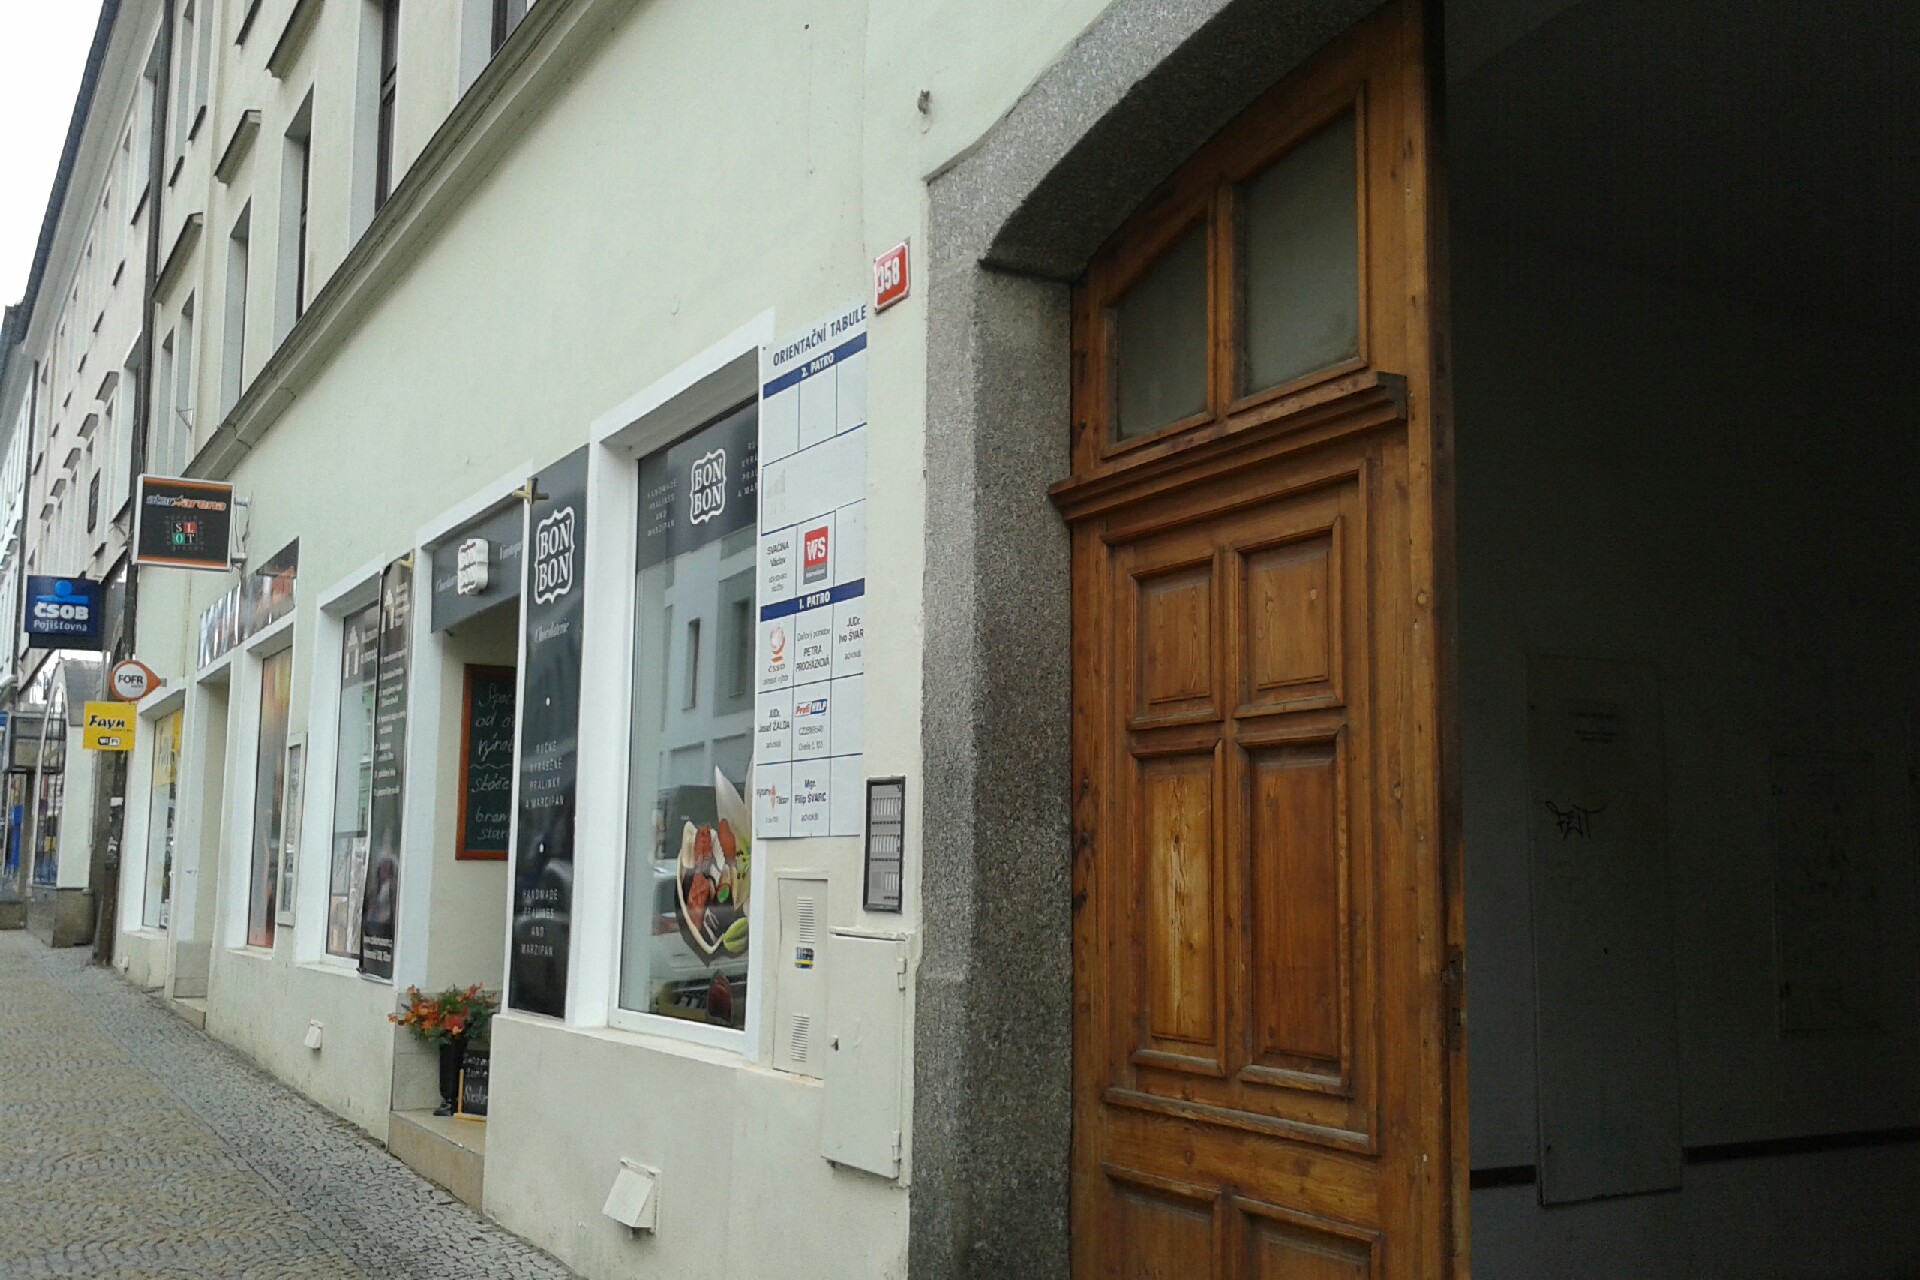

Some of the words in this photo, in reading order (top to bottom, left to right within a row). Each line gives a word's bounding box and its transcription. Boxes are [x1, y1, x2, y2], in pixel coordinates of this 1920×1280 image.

[773, 322, 827, 367] ORIENTAČNÍ
[830, 304, 867, 337] TABULE
[810, 352, 834, 376] PATRO
[694, 457, 723, 490] BON
[692, 483, 722, 516] BON
[539, 519, 571, 560] BON
[538, 551, 570, 592] BON
[35, 601, 89, 621] ČSOB
[807, 591, 831, 608] PATRO
[803, 645, 823, 657] PETRA
[118, 674, 144, 685] FOFR
[89, 714, 125, 730] Fayn
